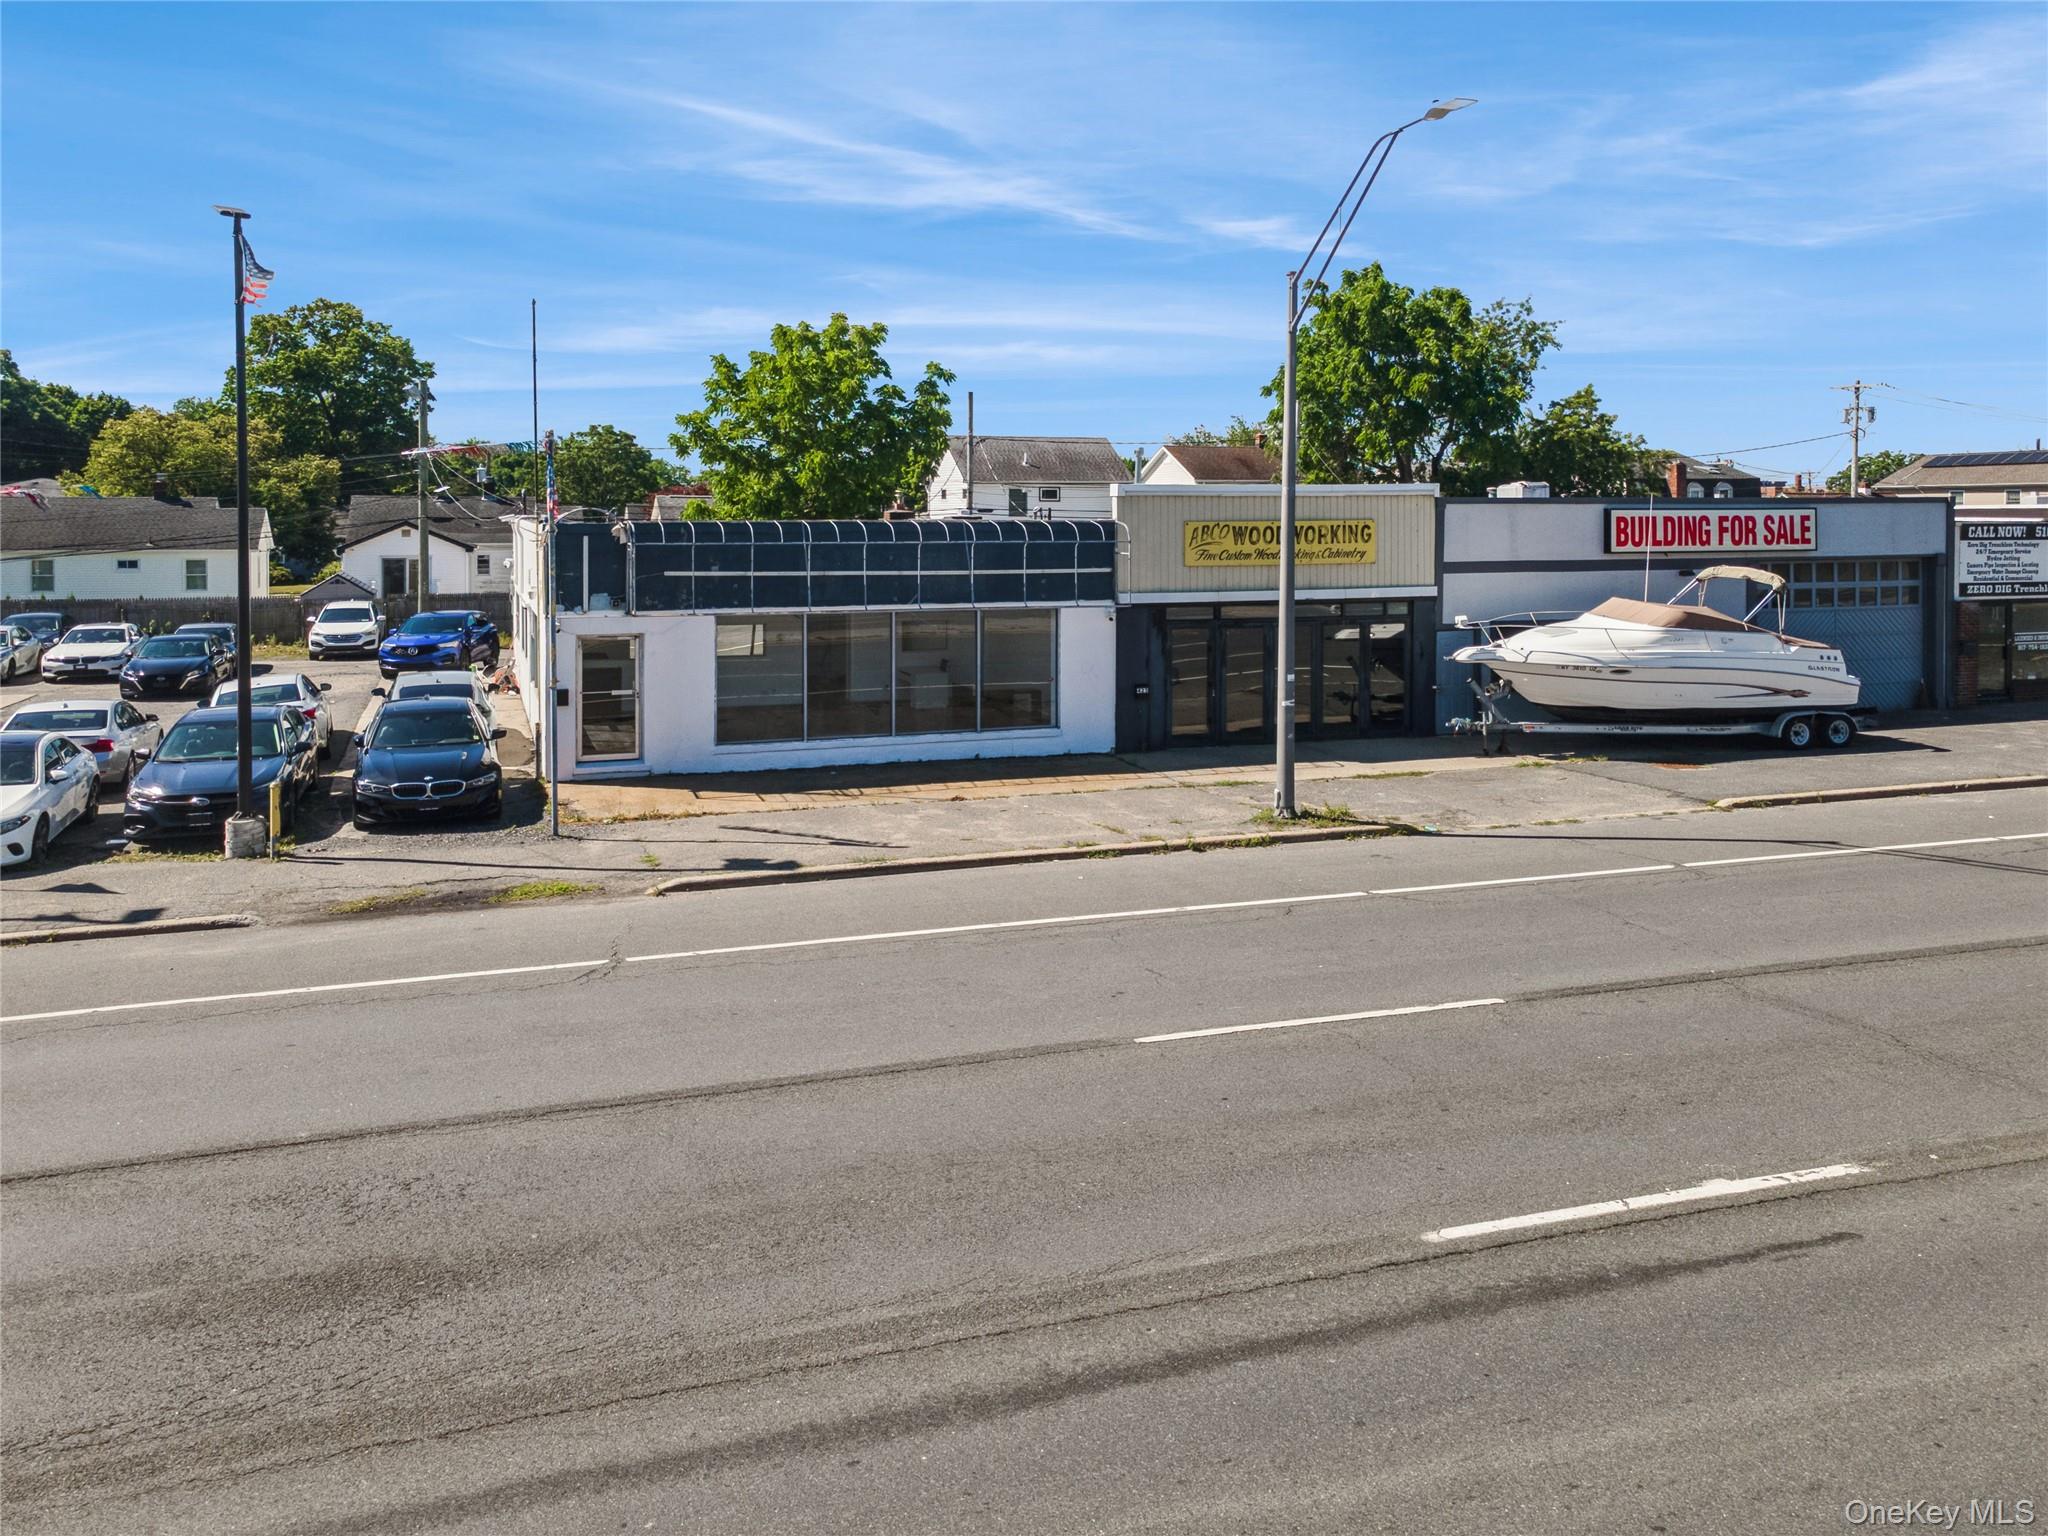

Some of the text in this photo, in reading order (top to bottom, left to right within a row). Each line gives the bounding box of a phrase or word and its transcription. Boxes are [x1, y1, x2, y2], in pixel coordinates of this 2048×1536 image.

[1189, 522, 1230, 547] ABCO
[1615, 514, 1812, 548] BUILDING FOR SALE
[1968, 525, 2048, 538] CALL NOW! 51
[1194, 550, 1219, 561] Fine
[1219, 550, 1252, 561] Custom
[1321, 548, 1367, 562] Cabinetry
[1967, 584, 1993, 594] ZERO
[1994, 584, 2012, 593] DIG
